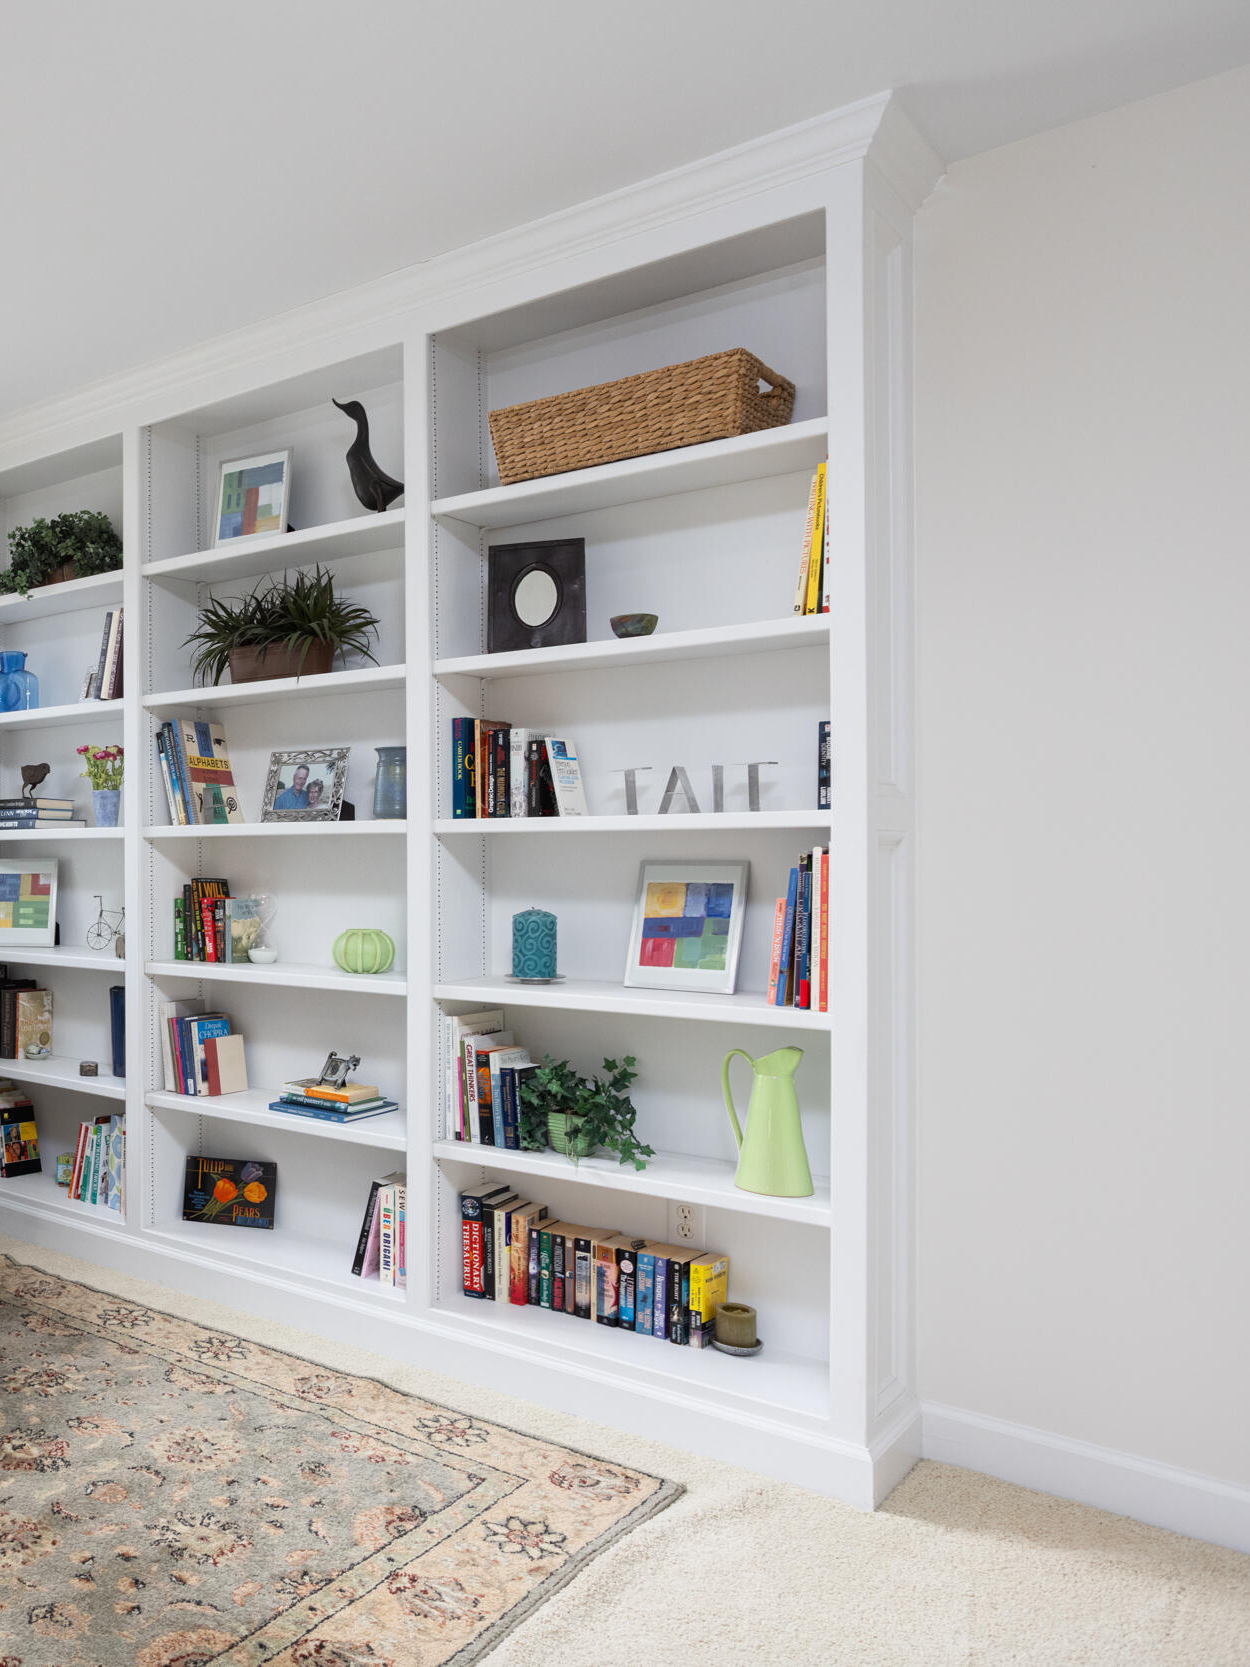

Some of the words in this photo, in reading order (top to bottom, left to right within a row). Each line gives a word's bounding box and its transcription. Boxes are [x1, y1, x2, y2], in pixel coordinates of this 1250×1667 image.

[189, 757, 229, 769] ALPHABETS
[203, 882, 226, 898] WILL
[199, 1028, 229, 1039] CHOPRA
[466, 1044, 474, 1068] GREAT
[468, 1069, 476, 1103] THINKERS
[198, 1158, 225, 1189] TULIP
[398, 1189, 406, 1211] SEW
[233, 1204, 261, 1222] PEARS
[383, 1207, 393, 1230] ÜBER
[383, 1233, 391, 1271] ORIGAMI
[462, 1224, 471, 1287] THESAURUS
[472, 1223, 481, 1291] DICTIONARY
